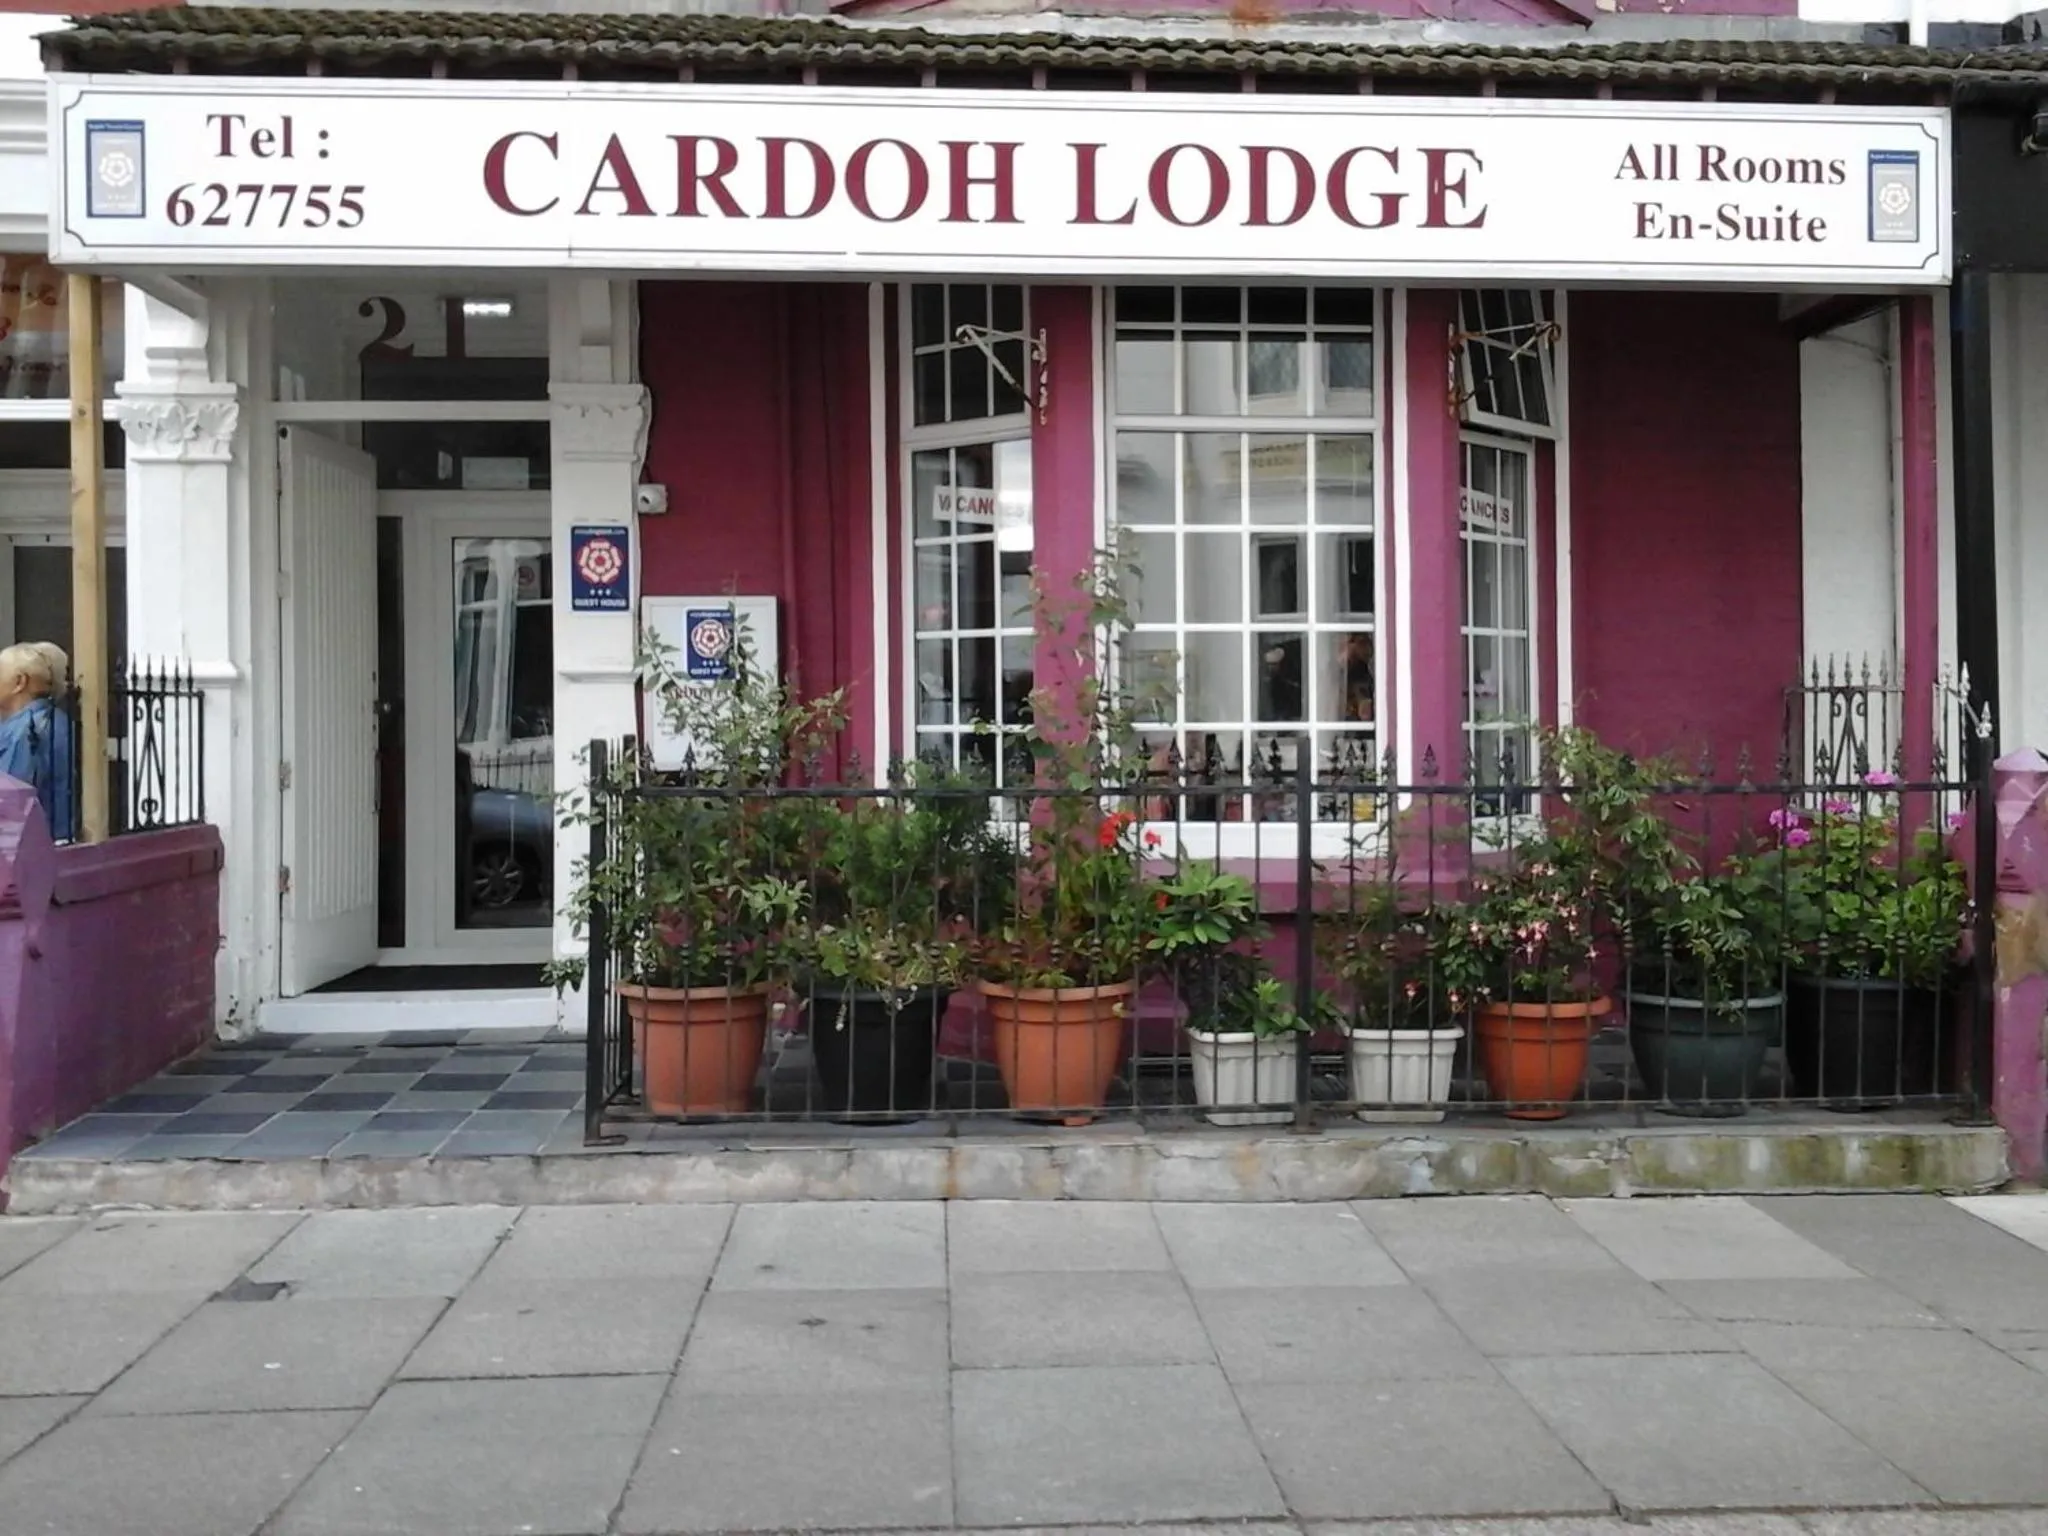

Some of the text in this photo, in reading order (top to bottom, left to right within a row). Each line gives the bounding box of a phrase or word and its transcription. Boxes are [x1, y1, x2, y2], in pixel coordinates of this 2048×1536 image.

[483, 131, 1488, 229] CARDOH LODGE
[1615, 144, 1846, 184] All Rooms
[166, 183, 365, 228] 627755
[1636, 202, 1827, 243] En-Suite
[358, 295, 468, 364] 21
